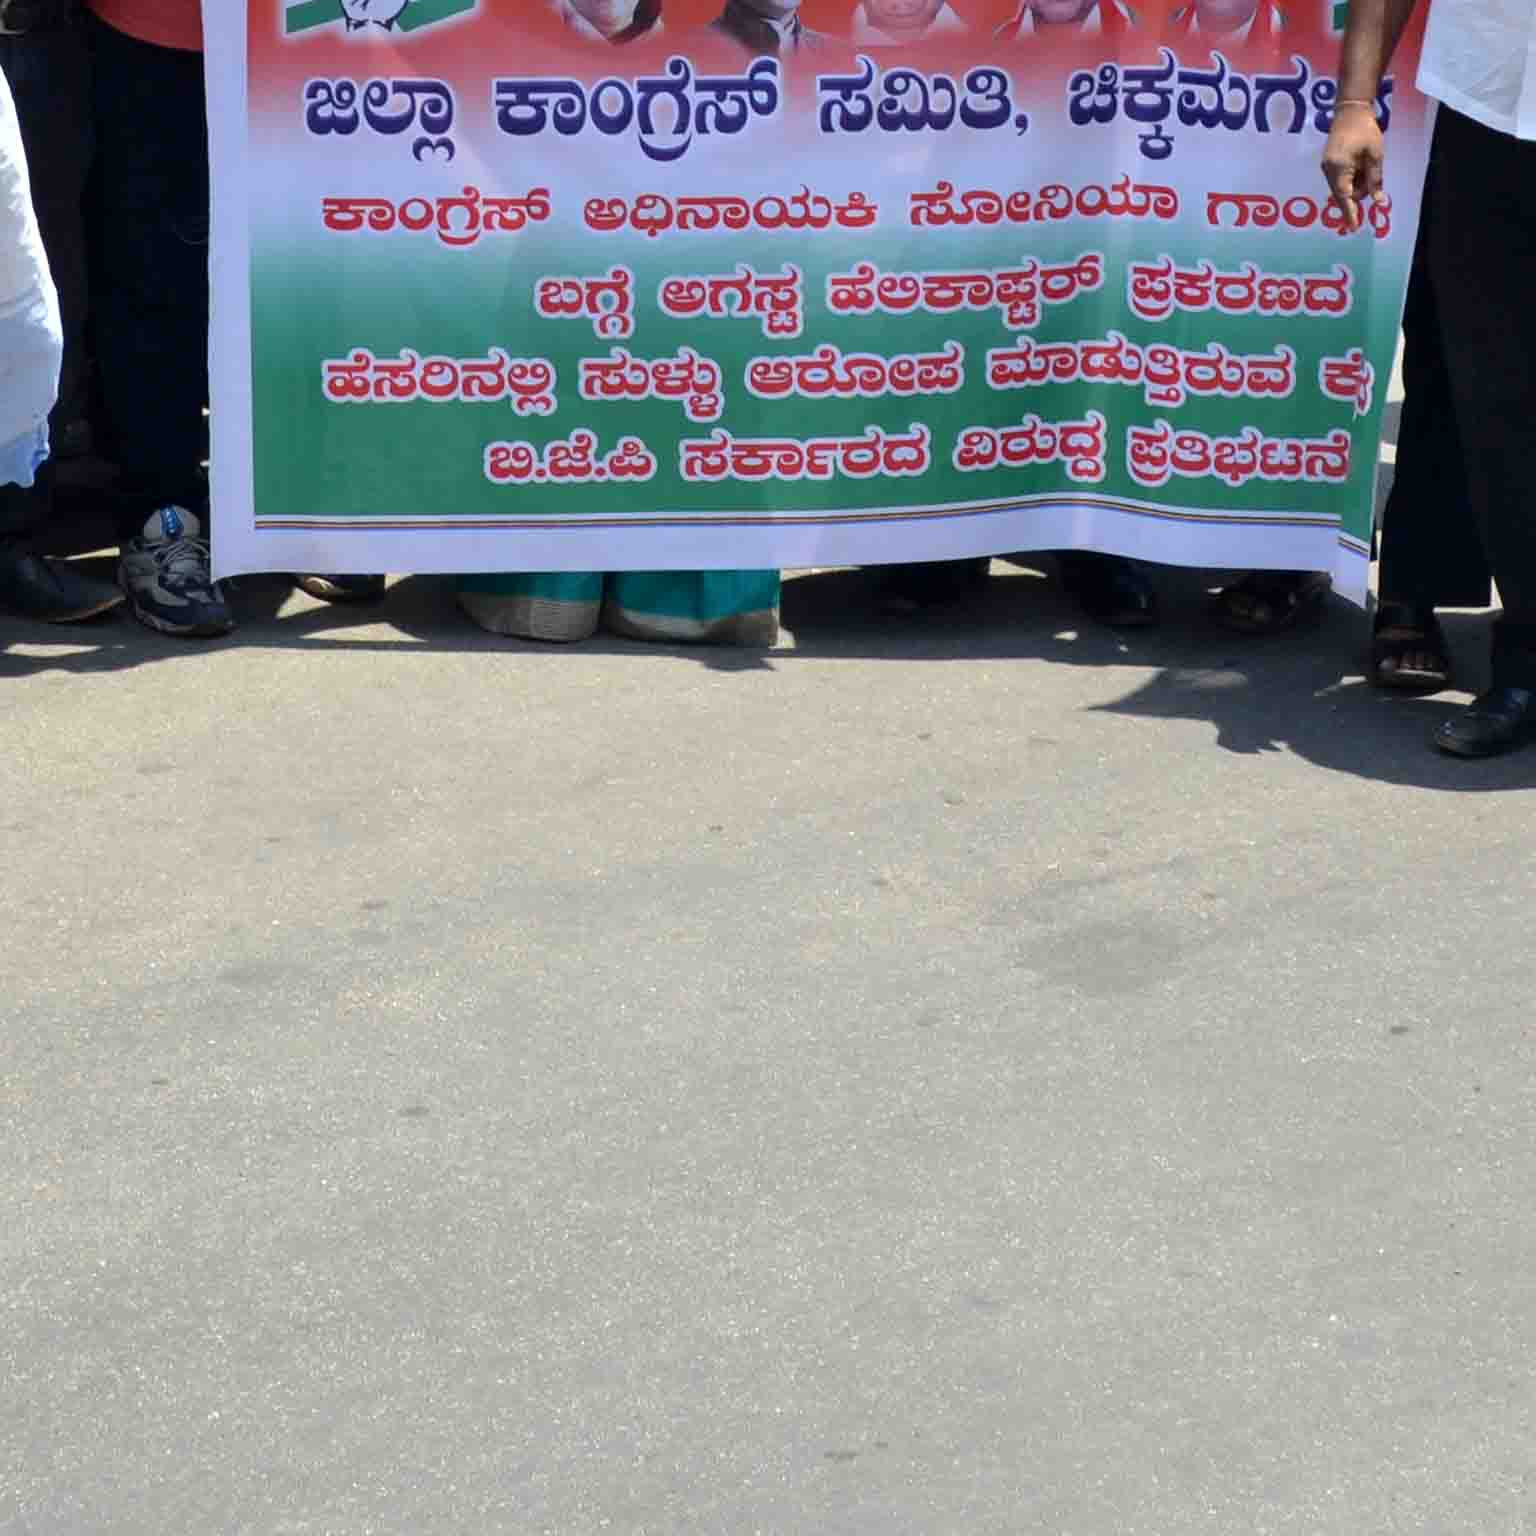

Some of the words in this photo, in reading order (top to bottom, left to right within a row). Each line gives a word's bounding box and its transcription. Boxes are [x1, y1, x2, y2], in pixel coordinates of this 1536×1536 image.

[307, 82, 454, 160] ಜಿಲ್ಲಾ
[496, 52, 777, 161] ಕಾಂಗ್ರೆಸ್
[821, 61, 1027, 136] ಸಮಿತಿ,
[323, 187, 550, 245] ಕಾಂಗ್ರೆಸ್
[586, 193, 875, 236] ಅಧಿನಾಯಕಿ
[912, 177, 1176, 224] ಸೋನಿಯಾ
[542, 272, 629, 333] ಬಗ್ಗೆ
[664, 273, 797, 333] ಅಗಸ್ಟ
[832, 256, 1099, 325] ಹೆಲಿಕಾಪ್ಟರ್
[1135, 268, 1345, 316] ಪ್ರಕರಣದ
[329, 354, 550, 408] ಹೆಸರಿನಲ್ಲಿ
[585, 358, 715, 416] ಸುಳ್ಳು
[752, 350, 959, 393] ಆರೋಪ
[992, 345, 1290, 401] ಮಾಡುತ್ತಿರುವ
[491, 436, 651, 478] ಬಿ.ಜೆ.ಪಿ
[687, 435, 925, 476] ಸರ್ಕಾರದ
[1132, 432, 1348, 481] ಪ್ರತಿಭಟನೆ
